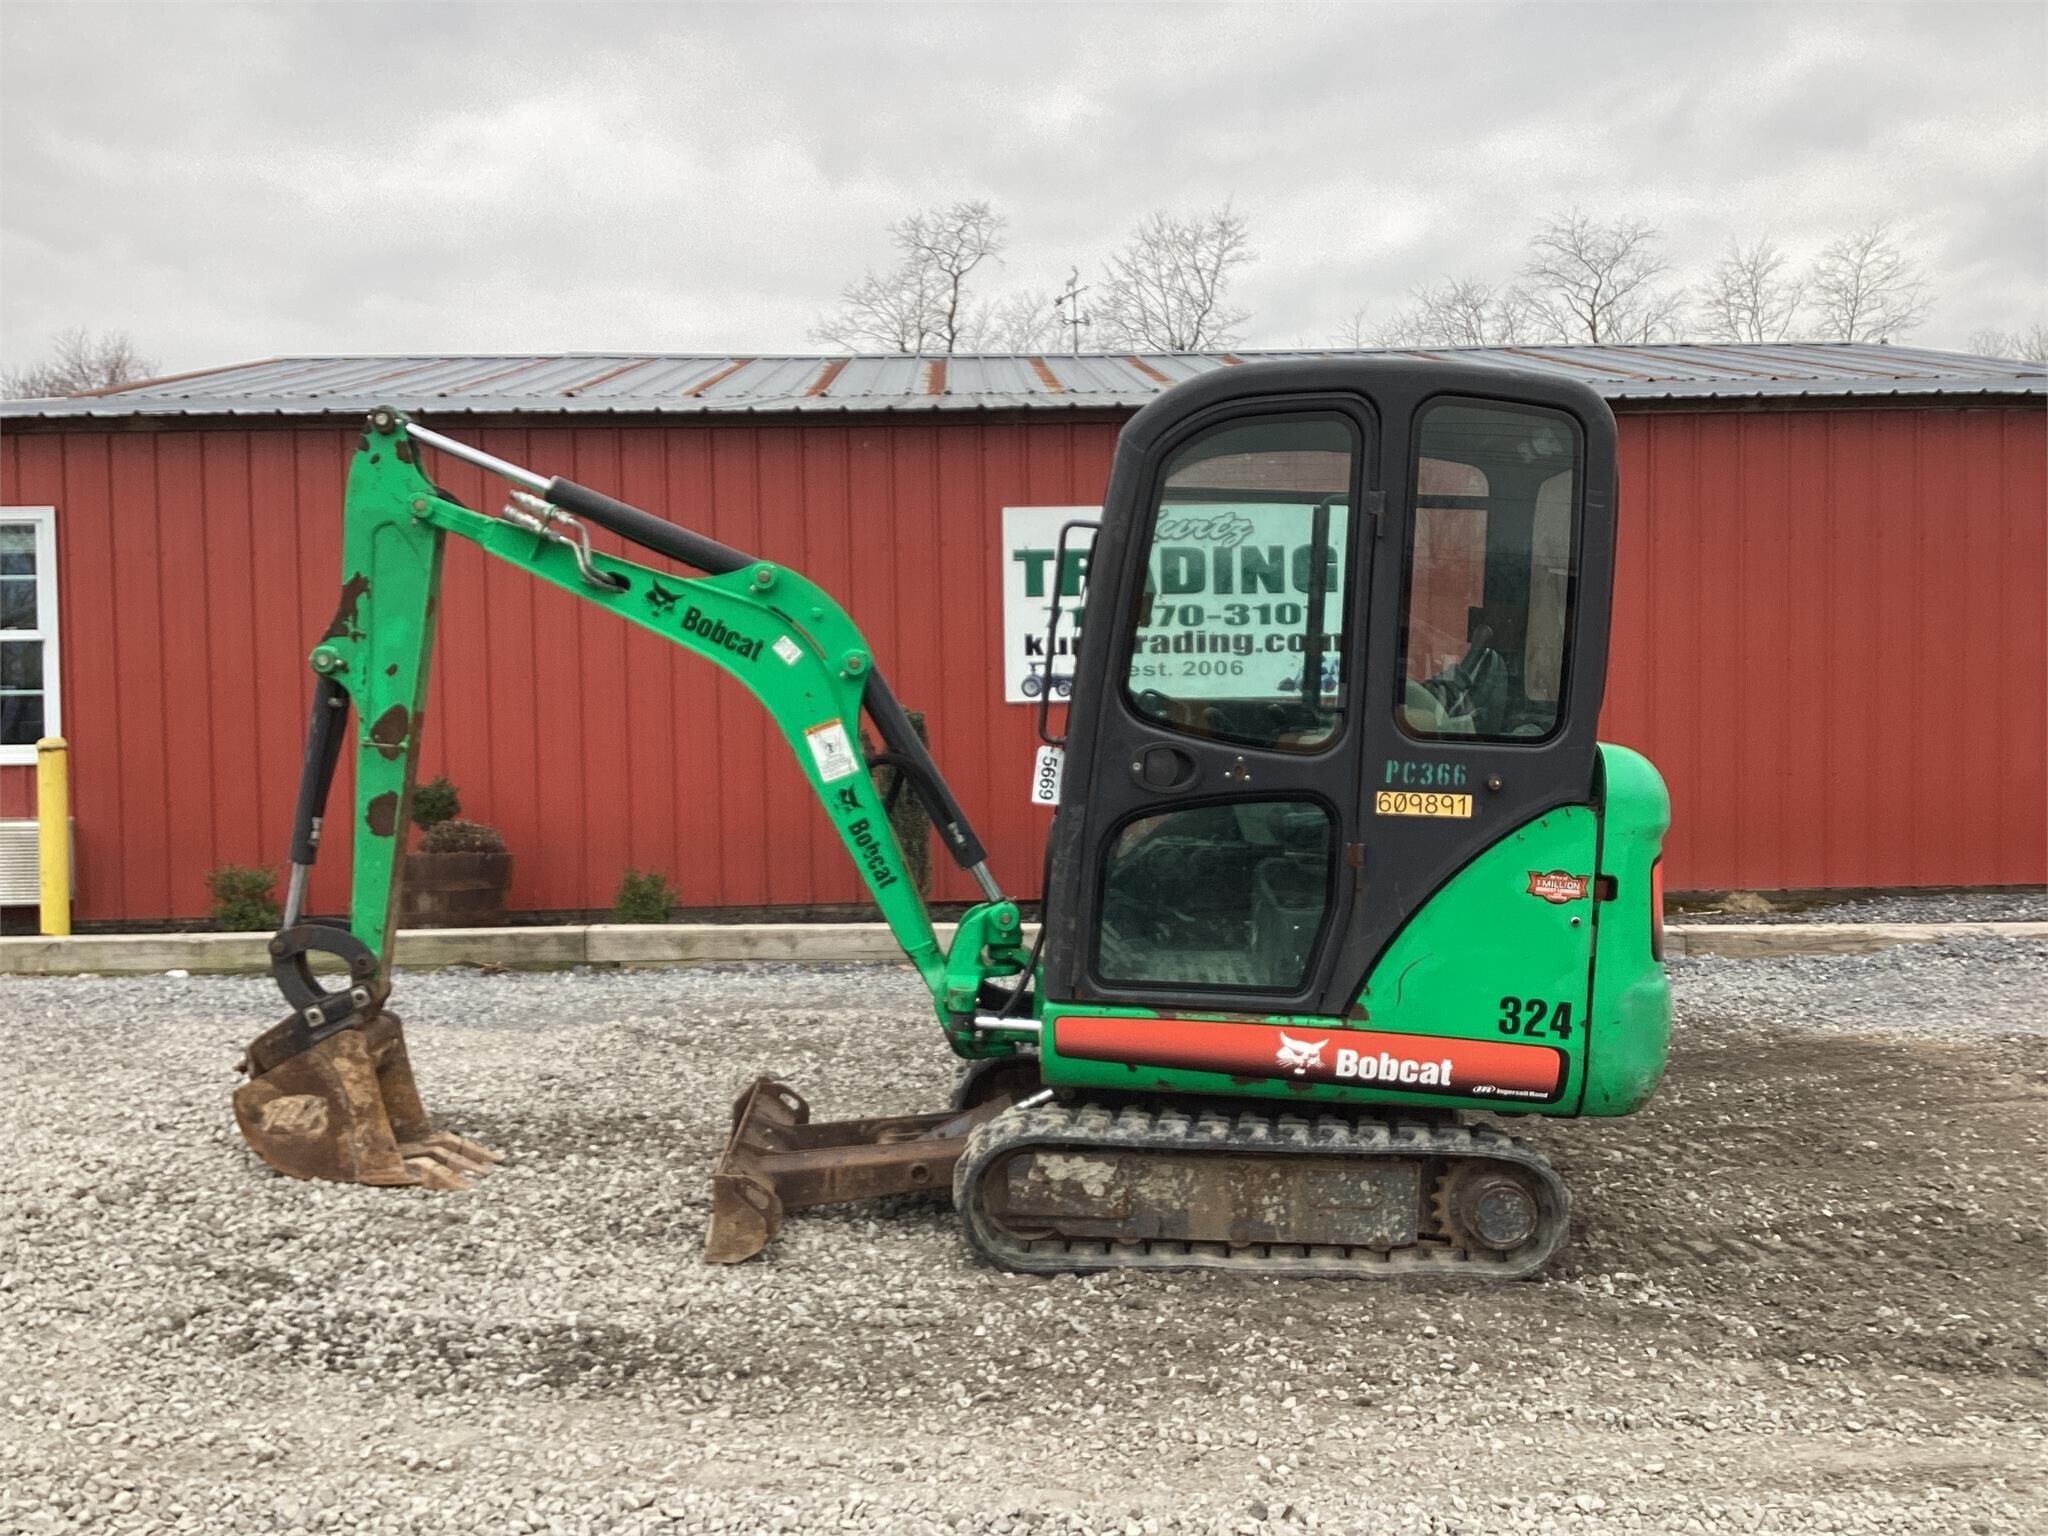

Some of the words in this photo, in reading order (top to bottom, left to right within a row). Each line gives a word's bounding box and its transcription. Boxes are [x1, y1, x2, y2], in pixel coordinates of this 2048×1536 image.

[1013, 545, 1337, 597] TRDING
[681, 605, 764, 662] Bobcat
[1130, 661, 1172, 677] est.
[1182, 660, 1244, 676] 2006
[1039, 756, 1058, 800] 5669
[1385, 760, 1466, 785] PC366
[1378, 792, 1467, 815] 609891
[848, 817, 898, 889] Bobcat
[1542, 880, 1580, 890] MILLION
[1498, 996, 1572, 1040] 324
[1336, 1049, 1453, 1086] Bobcat
